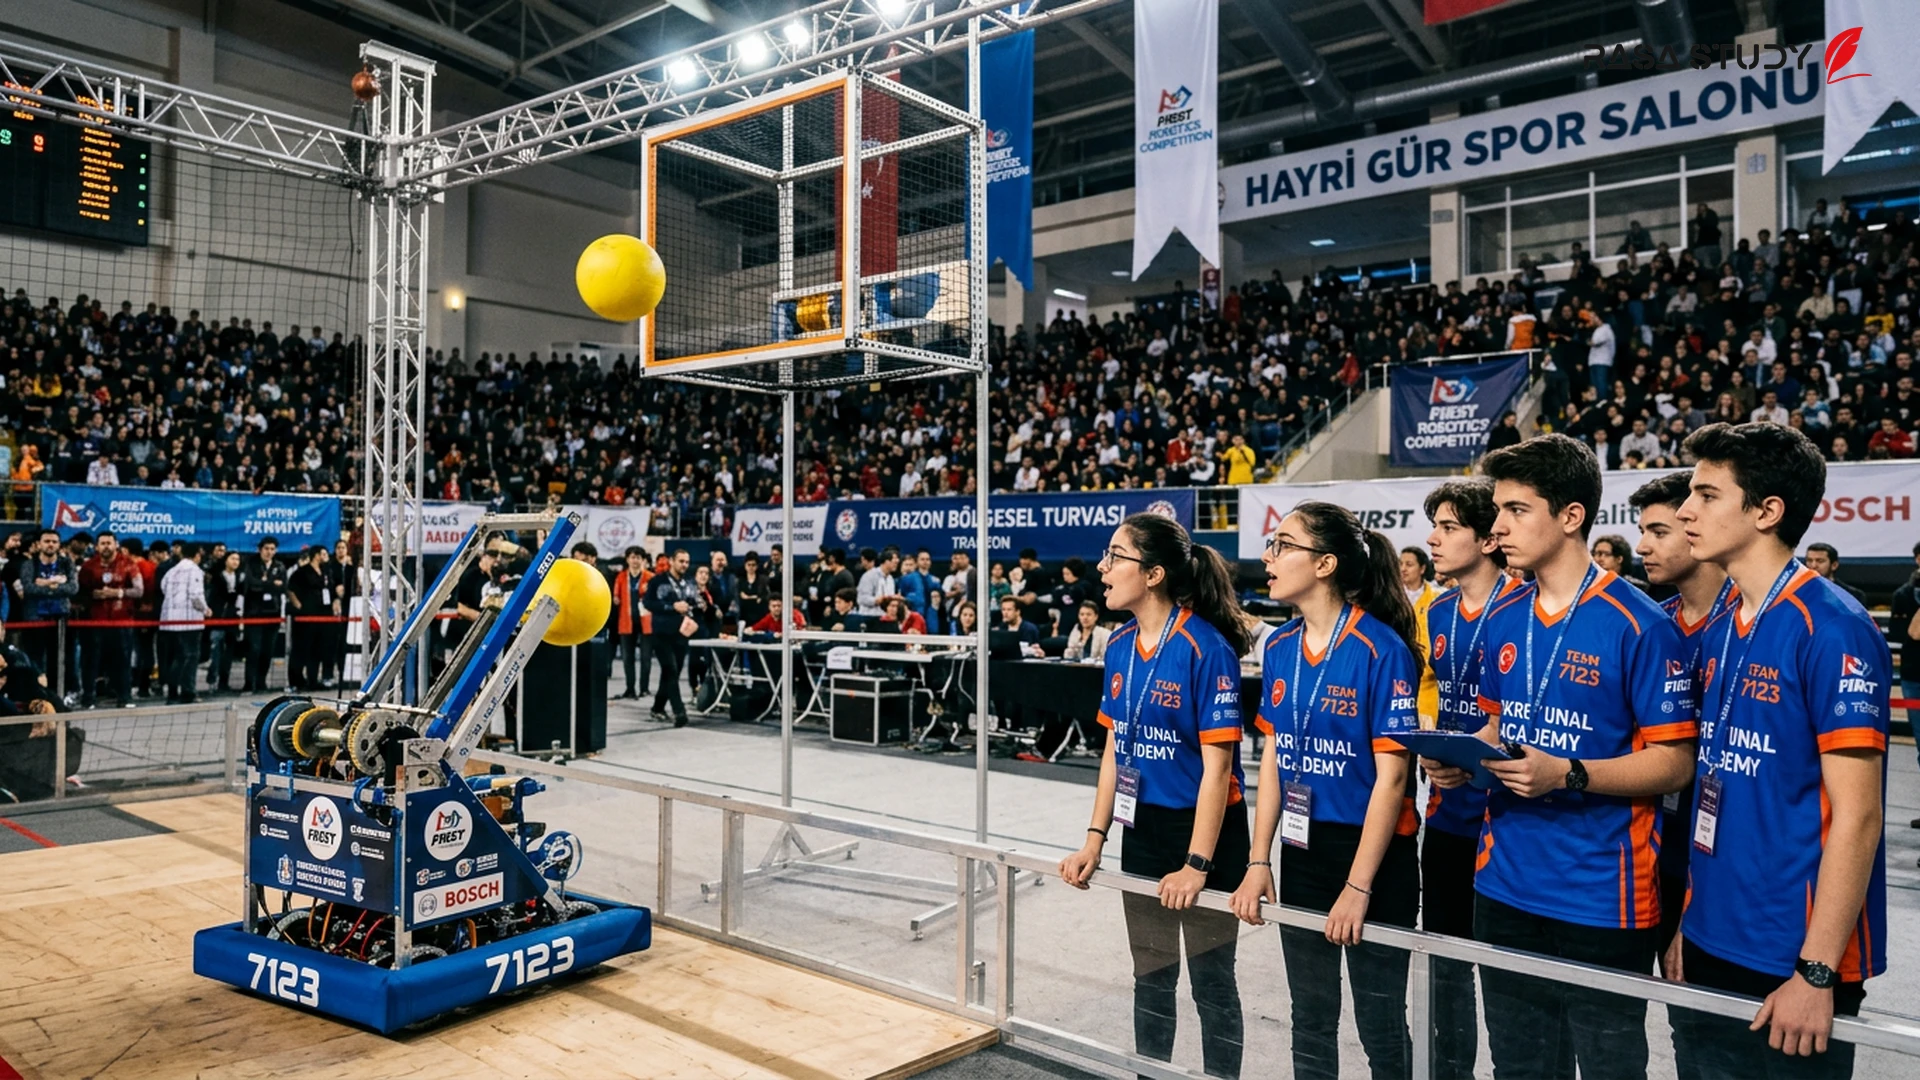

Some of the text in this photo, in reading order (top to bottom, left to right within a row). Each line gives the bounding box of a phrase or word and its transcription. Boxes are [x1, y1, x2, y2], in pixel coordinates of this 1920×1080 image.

[1246, 61, 1820, 207] HAYRİ GÜR SPOR SALONU
[869, 510, 945, 530] TRABZON
[1042, 505, 1126, 527] TURVASI
[1812, 495, 1910, 522] OSCH
[1320, 697, 1358, 717] 7123
[1544, 706, 1594, 732] UNAL
[1143, 725, 1182, 743] UNAL
[1313, 737, 1357, 758] UNAL
[1729, 726, 1777, 754] UNAL
[444, 880, 500, 908] BOSCH
[485, 936, 575, 995] 7123
[247, 952, 321, 1008] 7123
